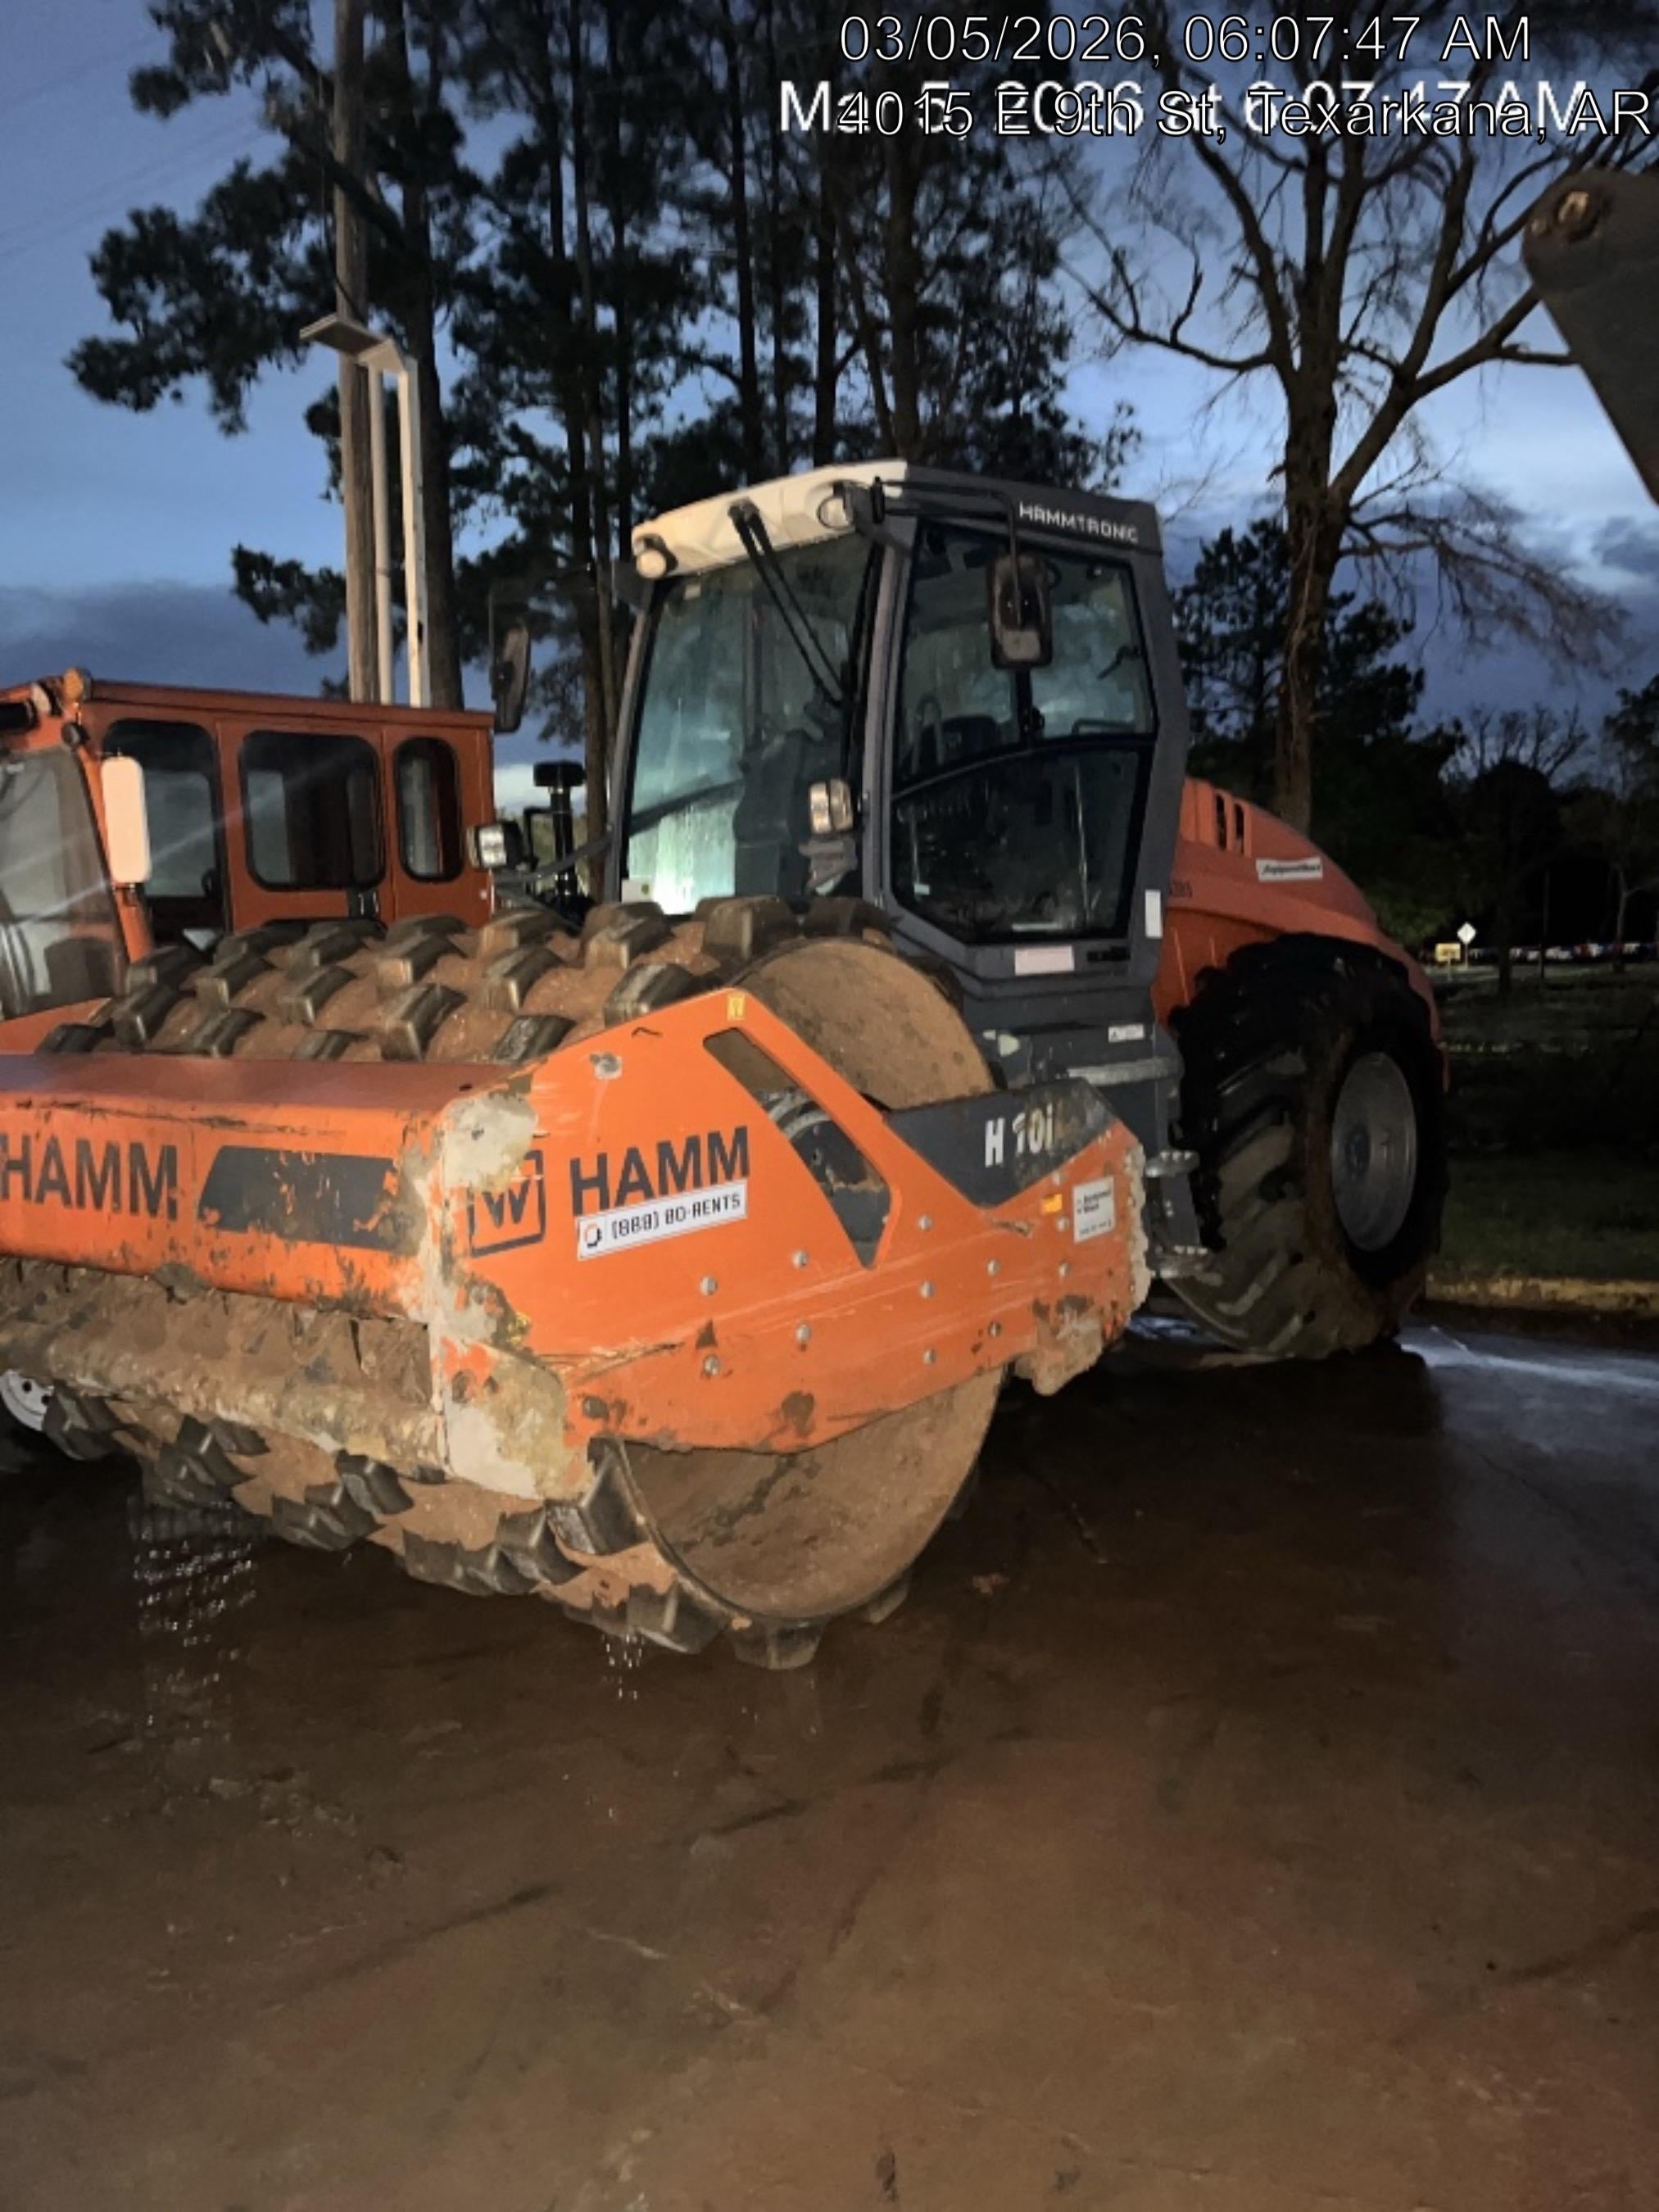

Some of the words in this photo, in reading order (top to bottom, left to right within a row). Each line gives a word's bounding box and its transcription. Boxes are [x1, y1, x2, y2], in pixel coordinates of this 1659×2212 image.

[1018, 501, 1140, 544] HAMMTRONIC
[0, 1131, 179, 1223] HAMM
[569, 1125, 750, 1217] HAMM
[985, 1117, 1005, 1168] H
